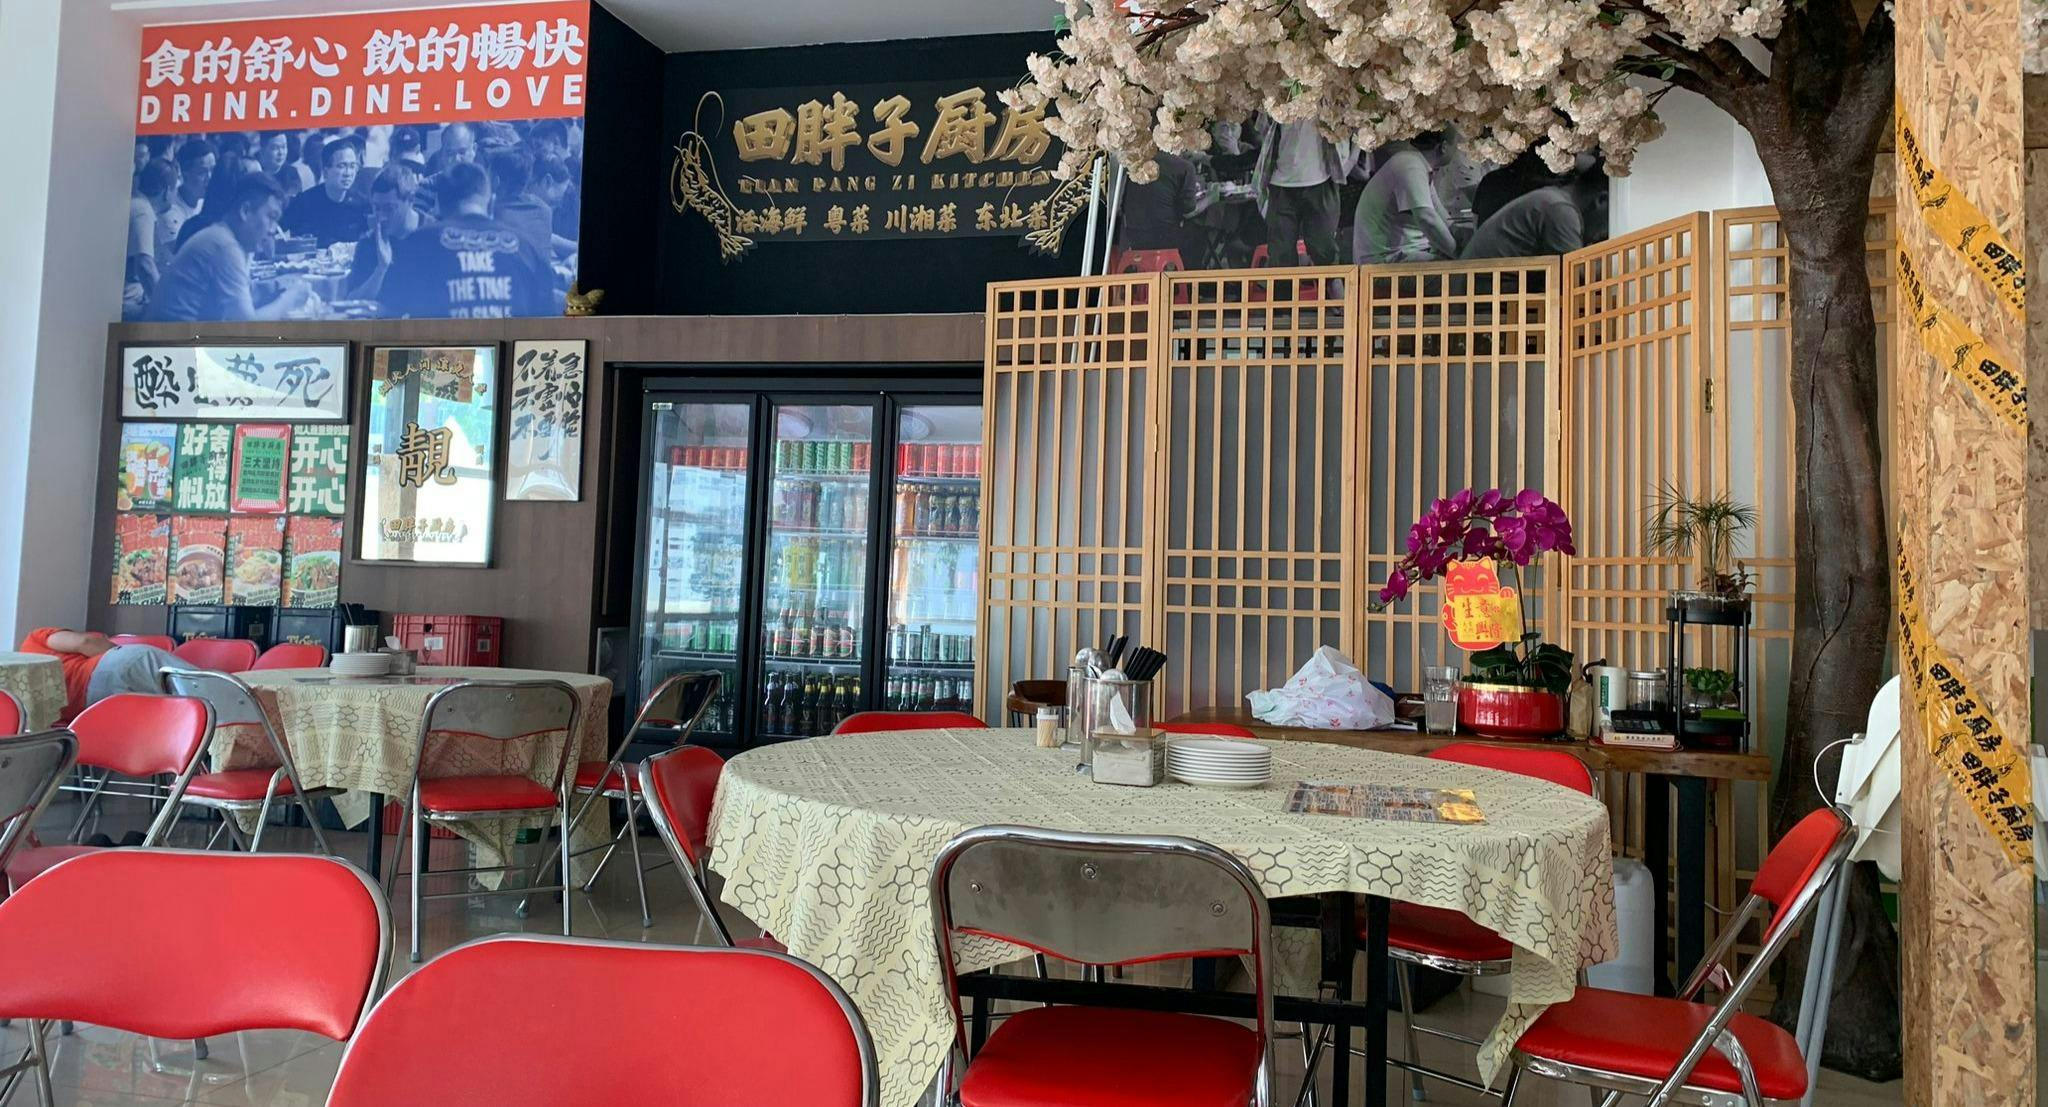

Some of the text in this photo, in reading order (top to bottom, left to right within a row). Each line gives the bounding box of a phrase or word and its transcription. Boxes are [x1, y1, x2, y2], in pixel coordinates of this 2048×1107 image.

[142, 17, 584, 88] 食的舒心 飲的暢快
[733, 86, 1051, 171] 田胖子厨房
[812, 175, 876, 193] PANG
[892, 174, 915, 191] ZI
[824, 203, 870, 235] 粤菜
[884, 201, 958, 235] 川湘菜
[975, 199, 1050, 233] 东北菜
[456, 250, 495, 273] TAKE
[447, 276, 512, 303] THE TIME
[292, 436, 348, 474] 开心
[289, 476, 346, 514] 开心
[1929, 661, 2003, 752] 田胖子厨房
[1961, 751, 2035, 842] 田胖子厨房
